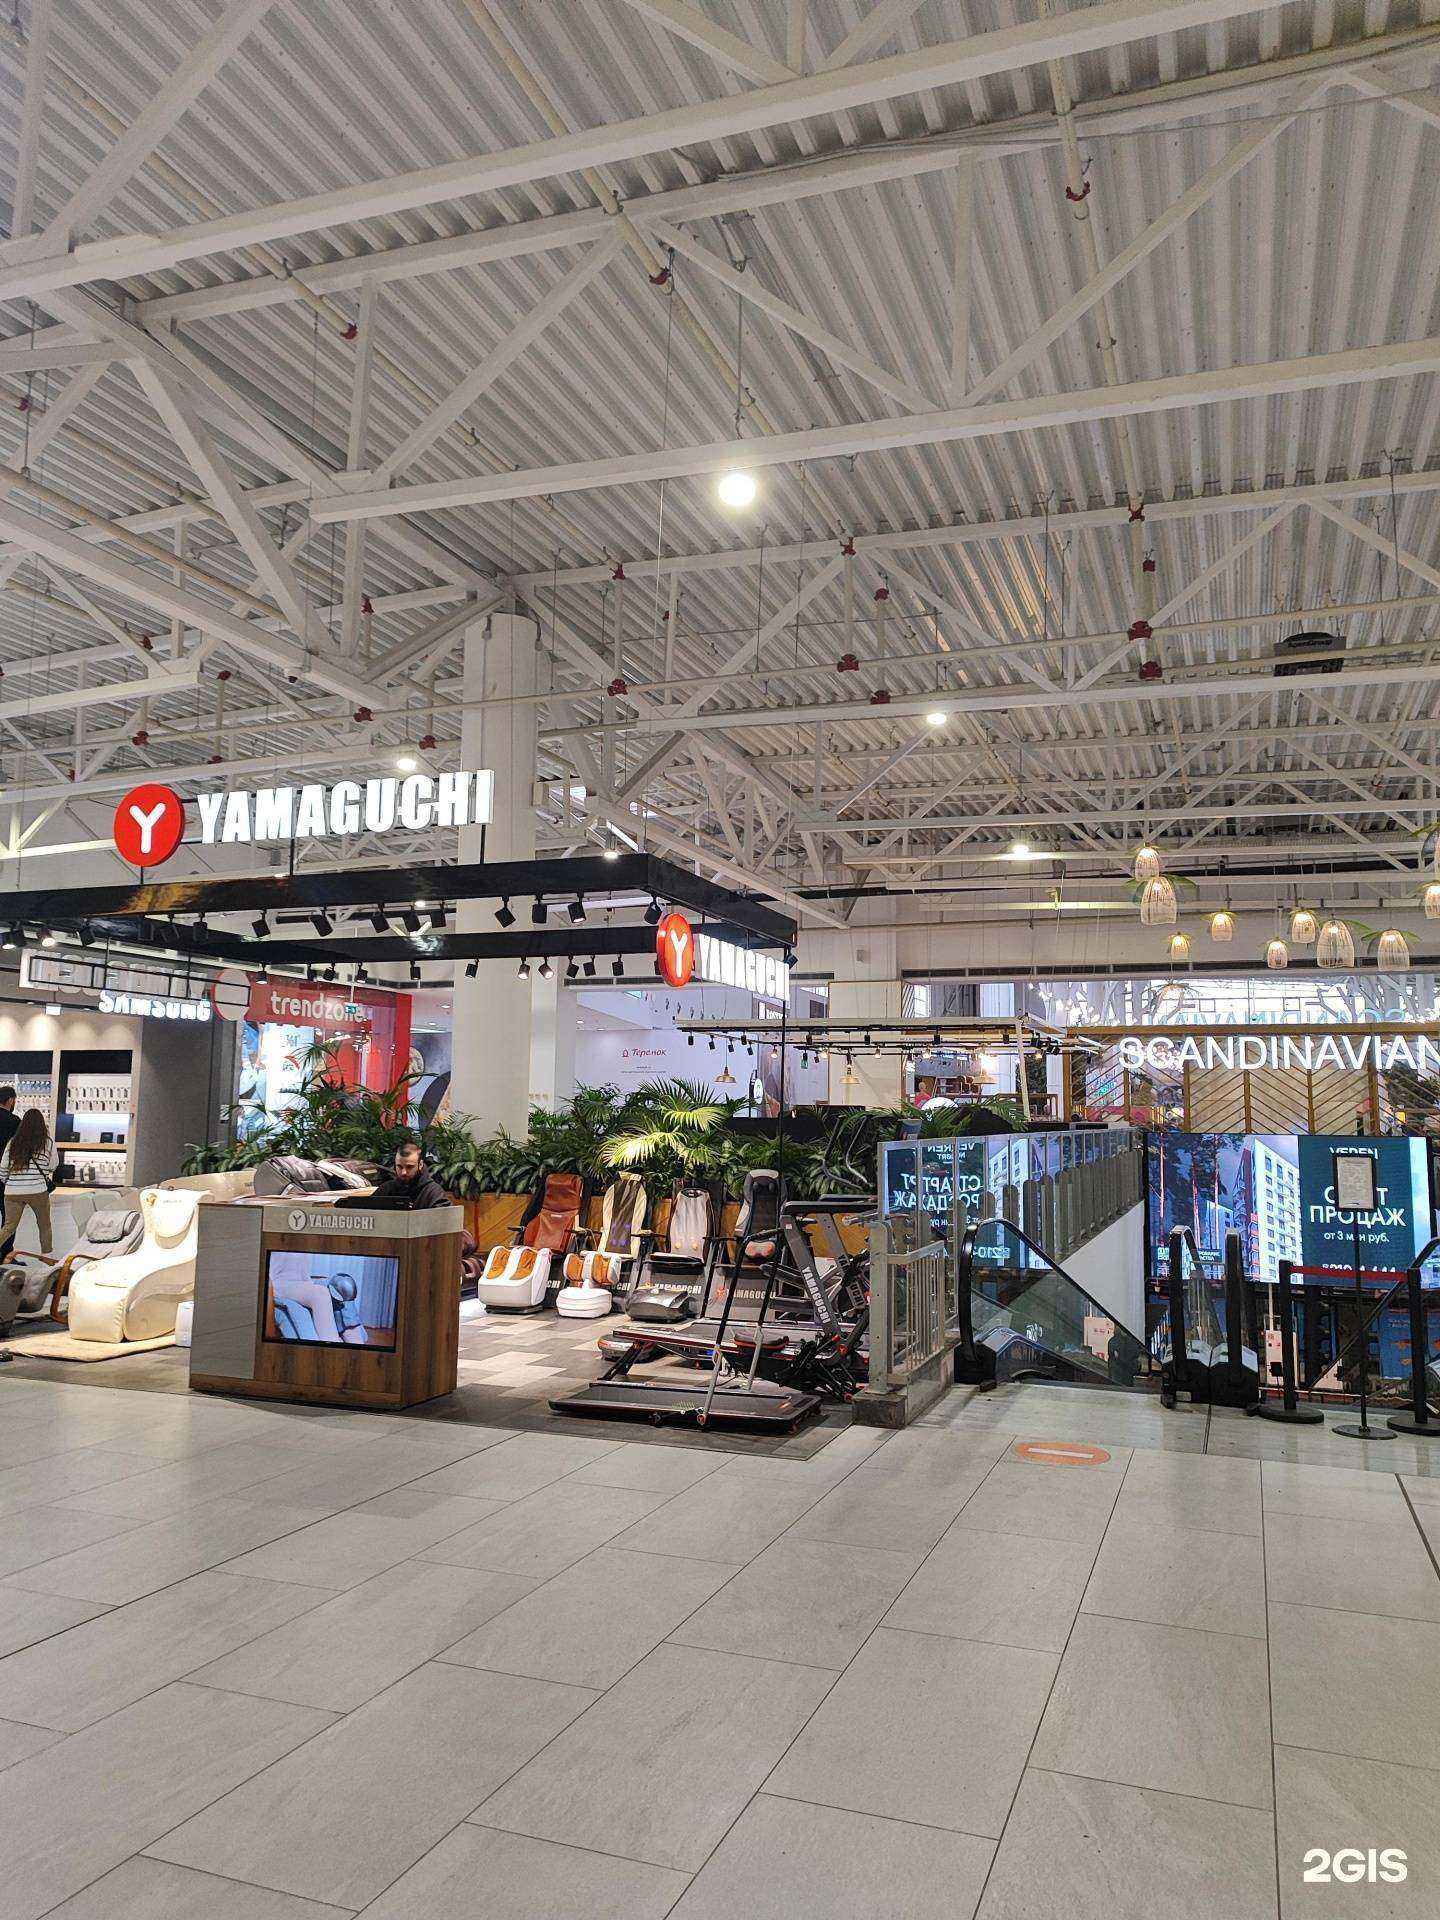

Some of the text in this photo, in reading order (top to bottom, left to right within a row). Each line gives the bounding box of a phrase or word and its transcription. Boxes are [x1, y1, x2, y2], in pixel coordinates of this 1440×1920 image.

[197, 769, 494, 844] YAMAGUCHI
[699, 932, 790, 1002] YAMAGUCHI
[98, 988, 211, 1022] SAMSUNG
[1118, 1034, 1440, 1070] SCANDINAVIAN
[309, 1215, 374, 1230] YAMAGUCHI
[1324, 1231, 1390, 1244] от 3 мн руб.
[801, 1266, 831, 1324] YAMAGUCHI
